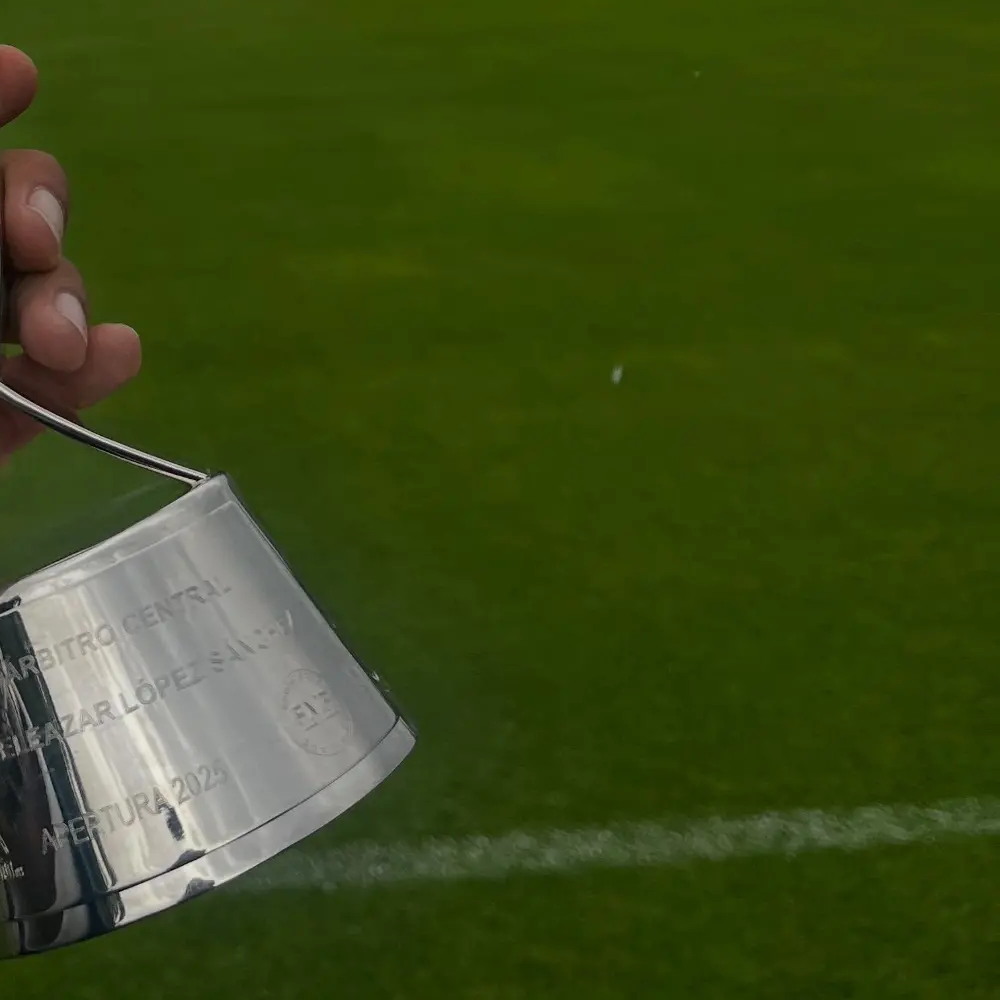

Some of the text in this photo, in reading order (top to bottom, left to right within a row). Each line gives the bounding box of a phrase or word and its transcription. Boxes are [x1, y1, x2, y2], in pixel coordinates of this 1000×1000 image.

[122, 576, 232, 634] CENTRAL
[118, 660, 206, 714] LÓPEZ
[41, 786, 168, 855] APERTURA
